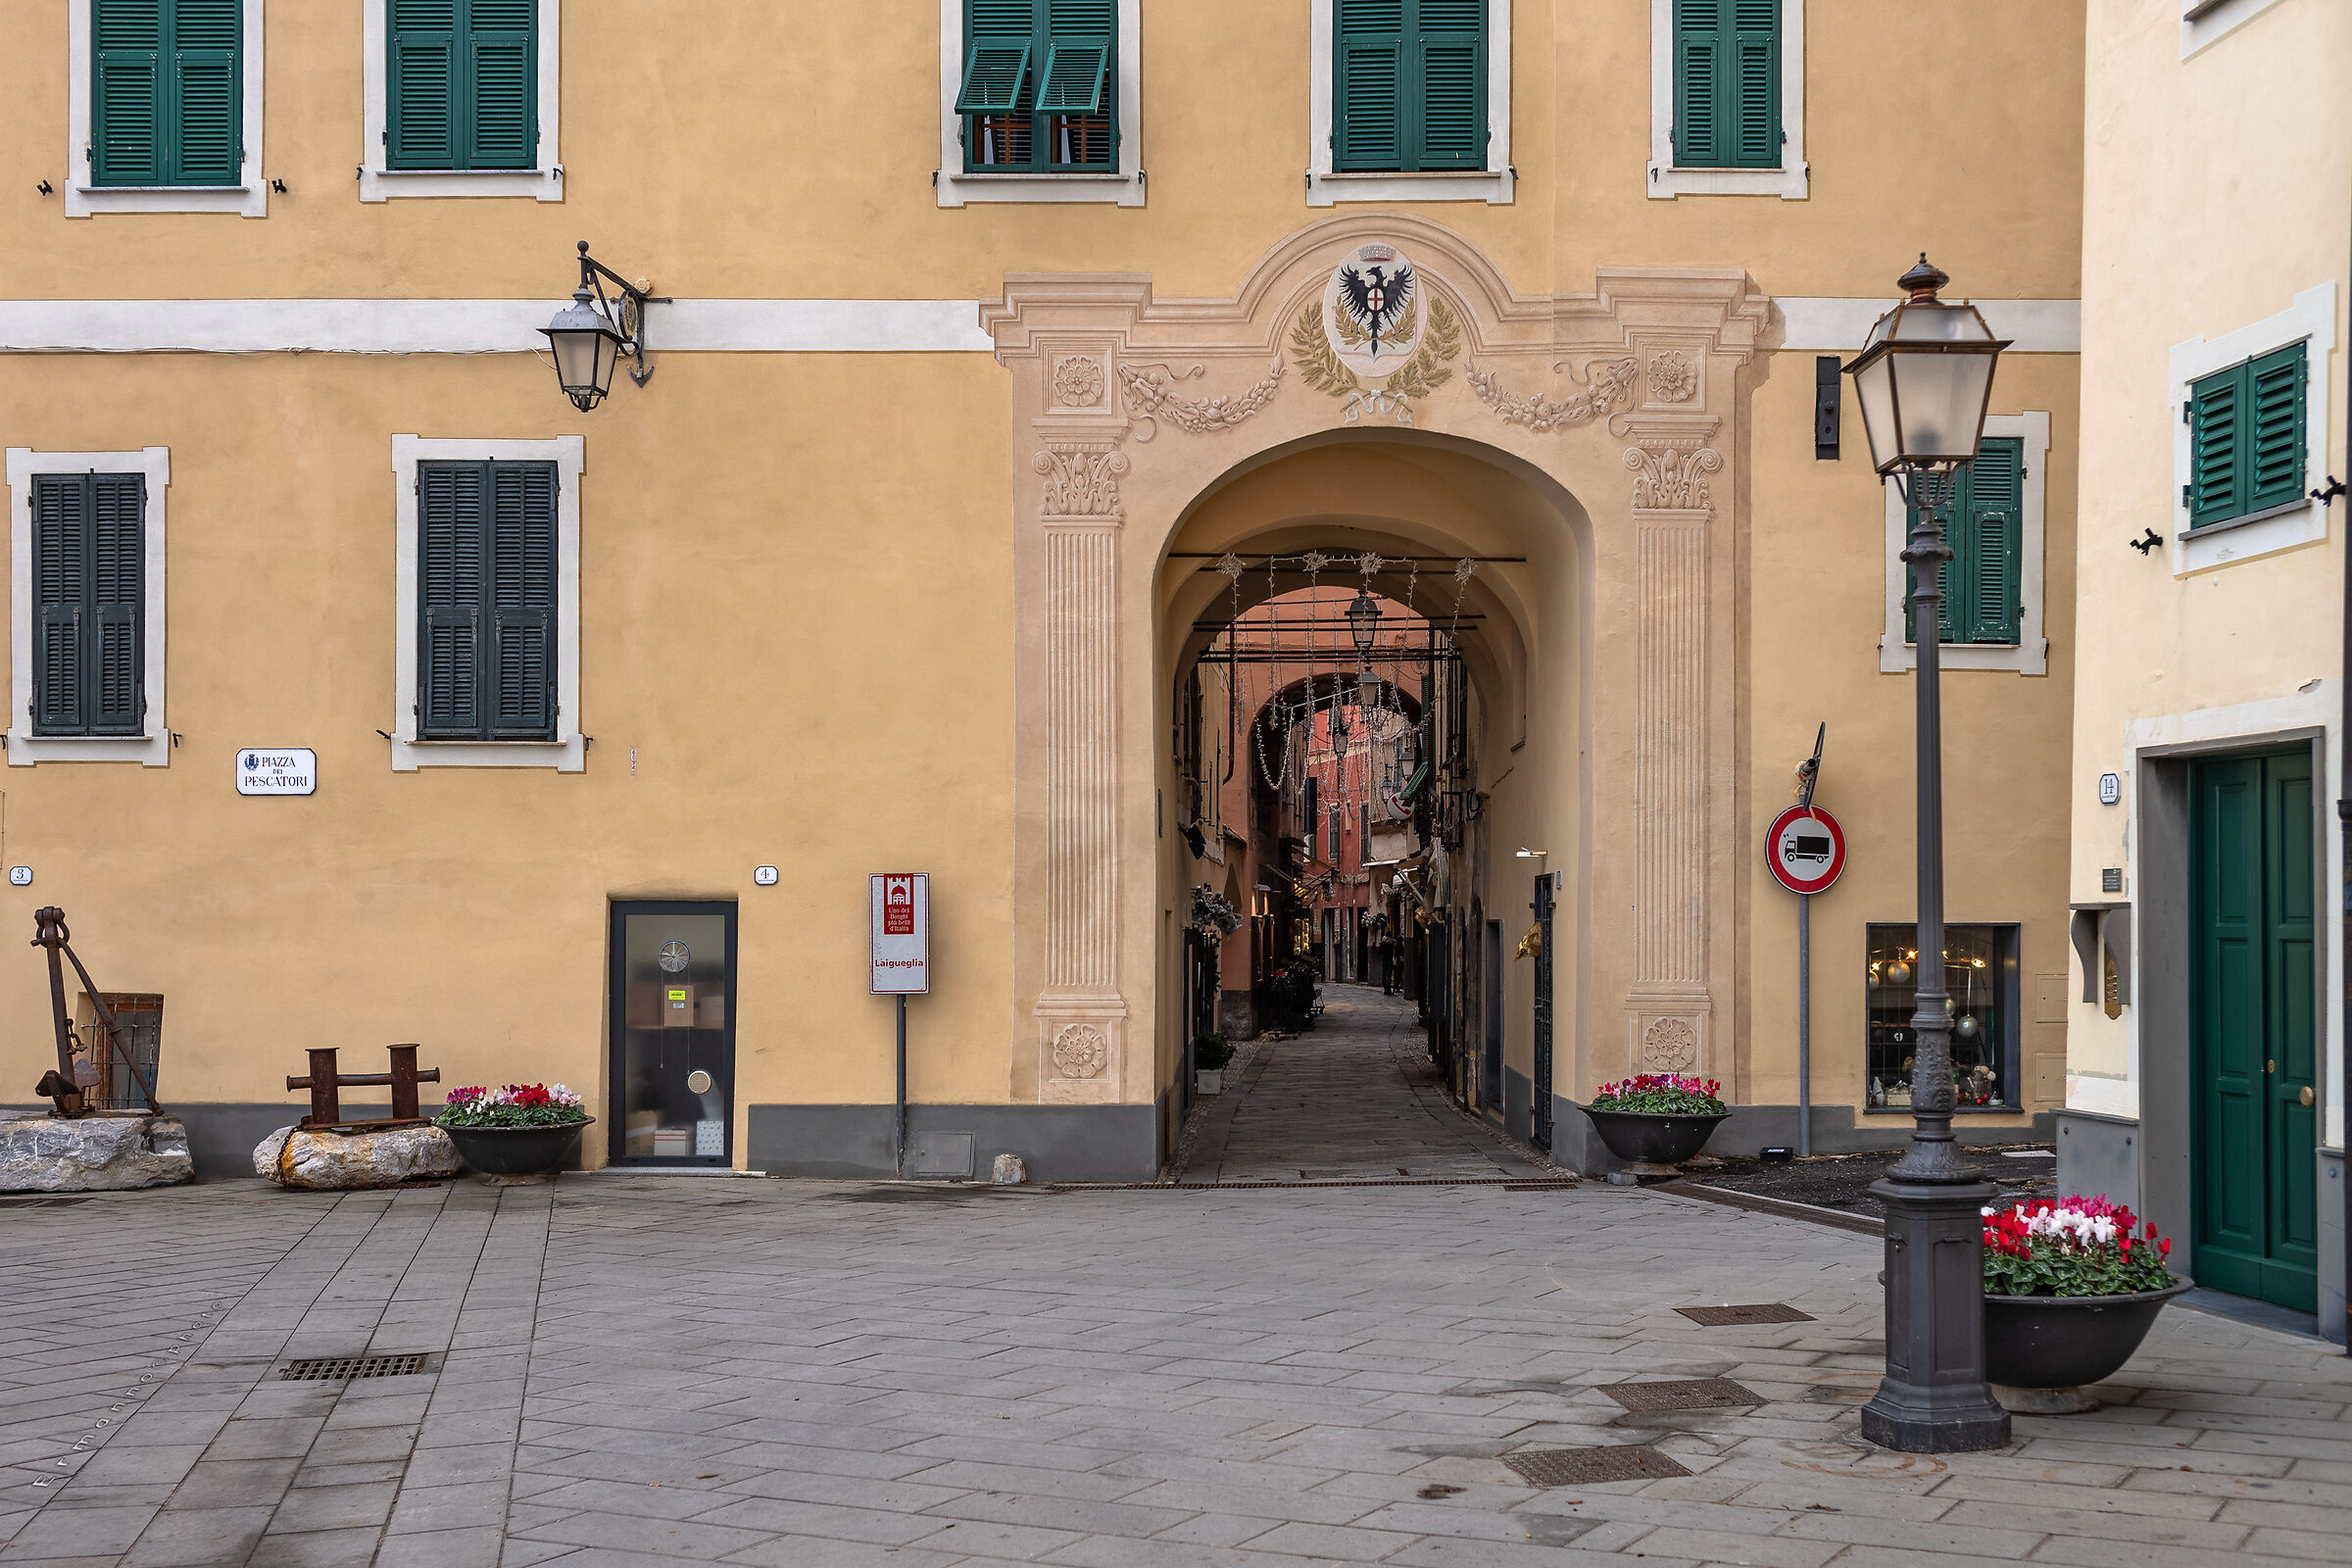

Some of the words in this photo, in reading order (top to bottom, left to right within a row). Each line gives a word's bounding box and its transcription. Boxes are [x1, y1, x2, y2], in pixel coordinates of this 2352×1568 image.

[262, 757, 296, 767] PIAZZA
[244, 775, 308, 787] PESCATORI
[2104, 777, 2115, 795] 14
[16, 868, 24, 880] 3
[760, 868, 769, 879] 4
[875, 958, 923, 968] Laigueglia
